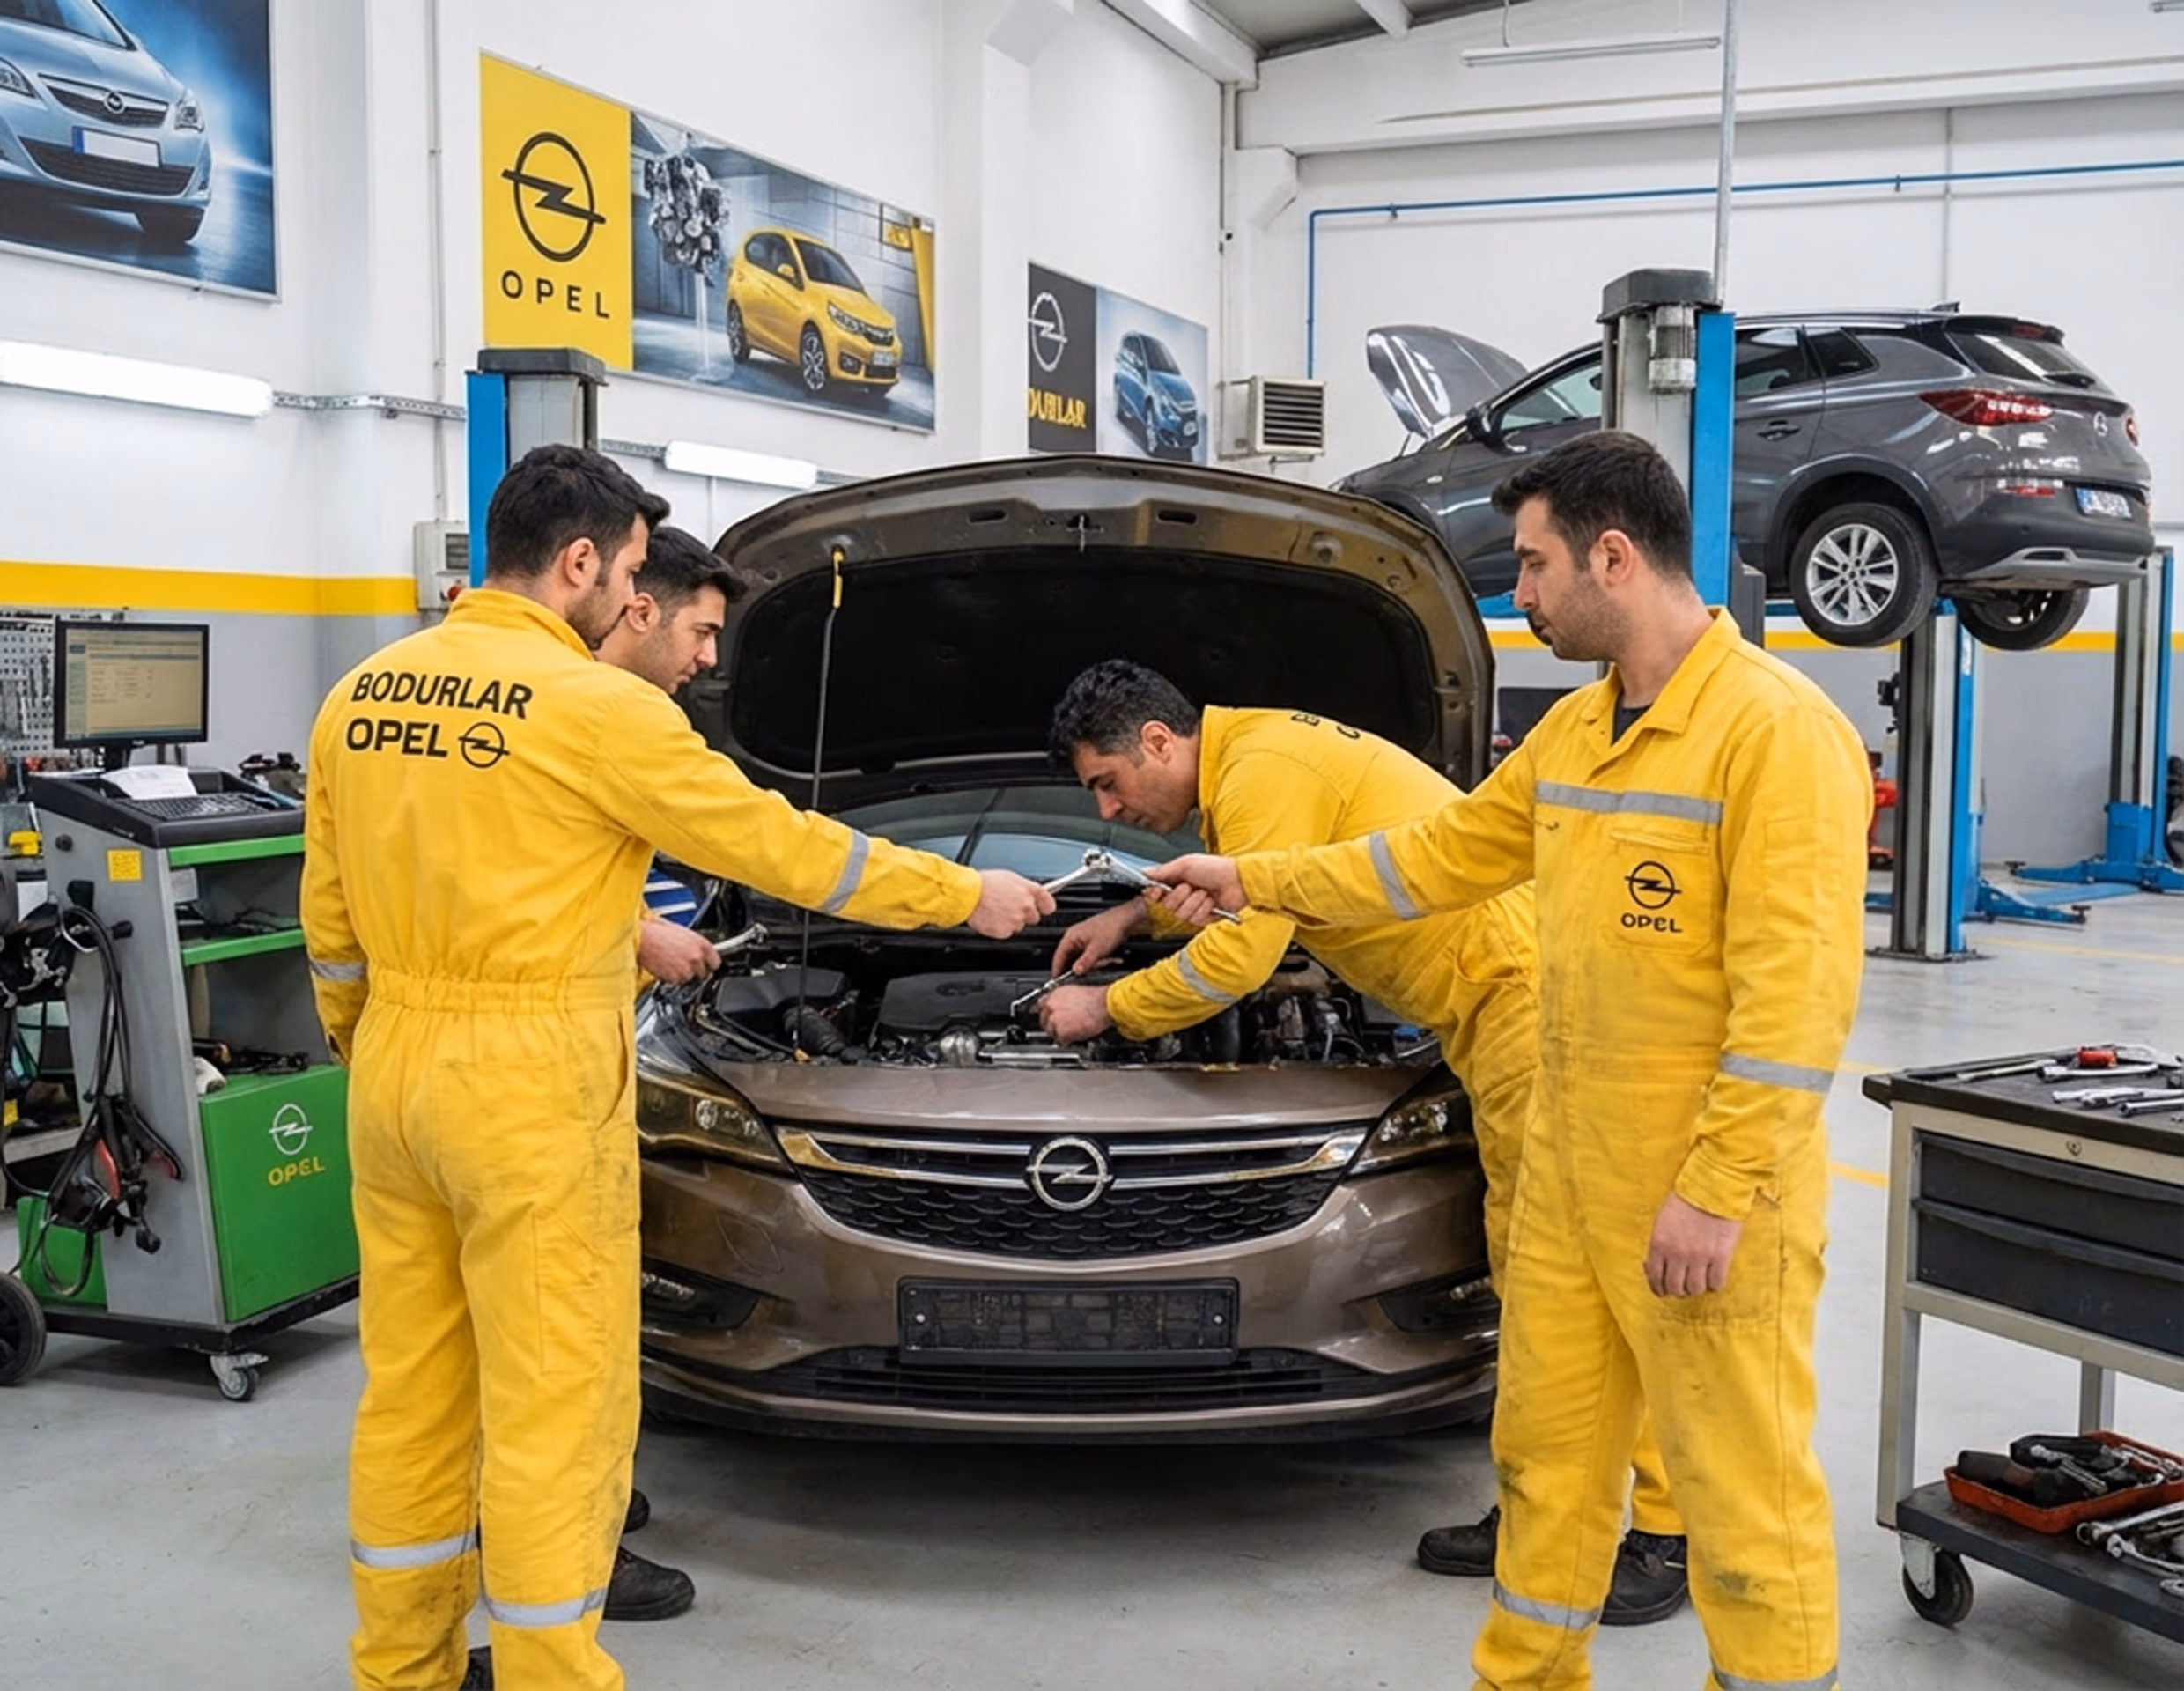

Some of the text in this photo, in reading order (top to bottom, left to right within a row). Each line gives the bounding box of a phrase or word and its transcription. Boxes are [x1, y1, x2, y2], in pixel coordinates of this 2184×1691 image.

[501, 270, 609, 318] OPEL
[350, 671, 533, 720] BODURLAR
[346, 717, 448, 757] OPEL
[1620, 912, 1683, 934] OPEL
[268, 1156, 326, 1186] OPEL
